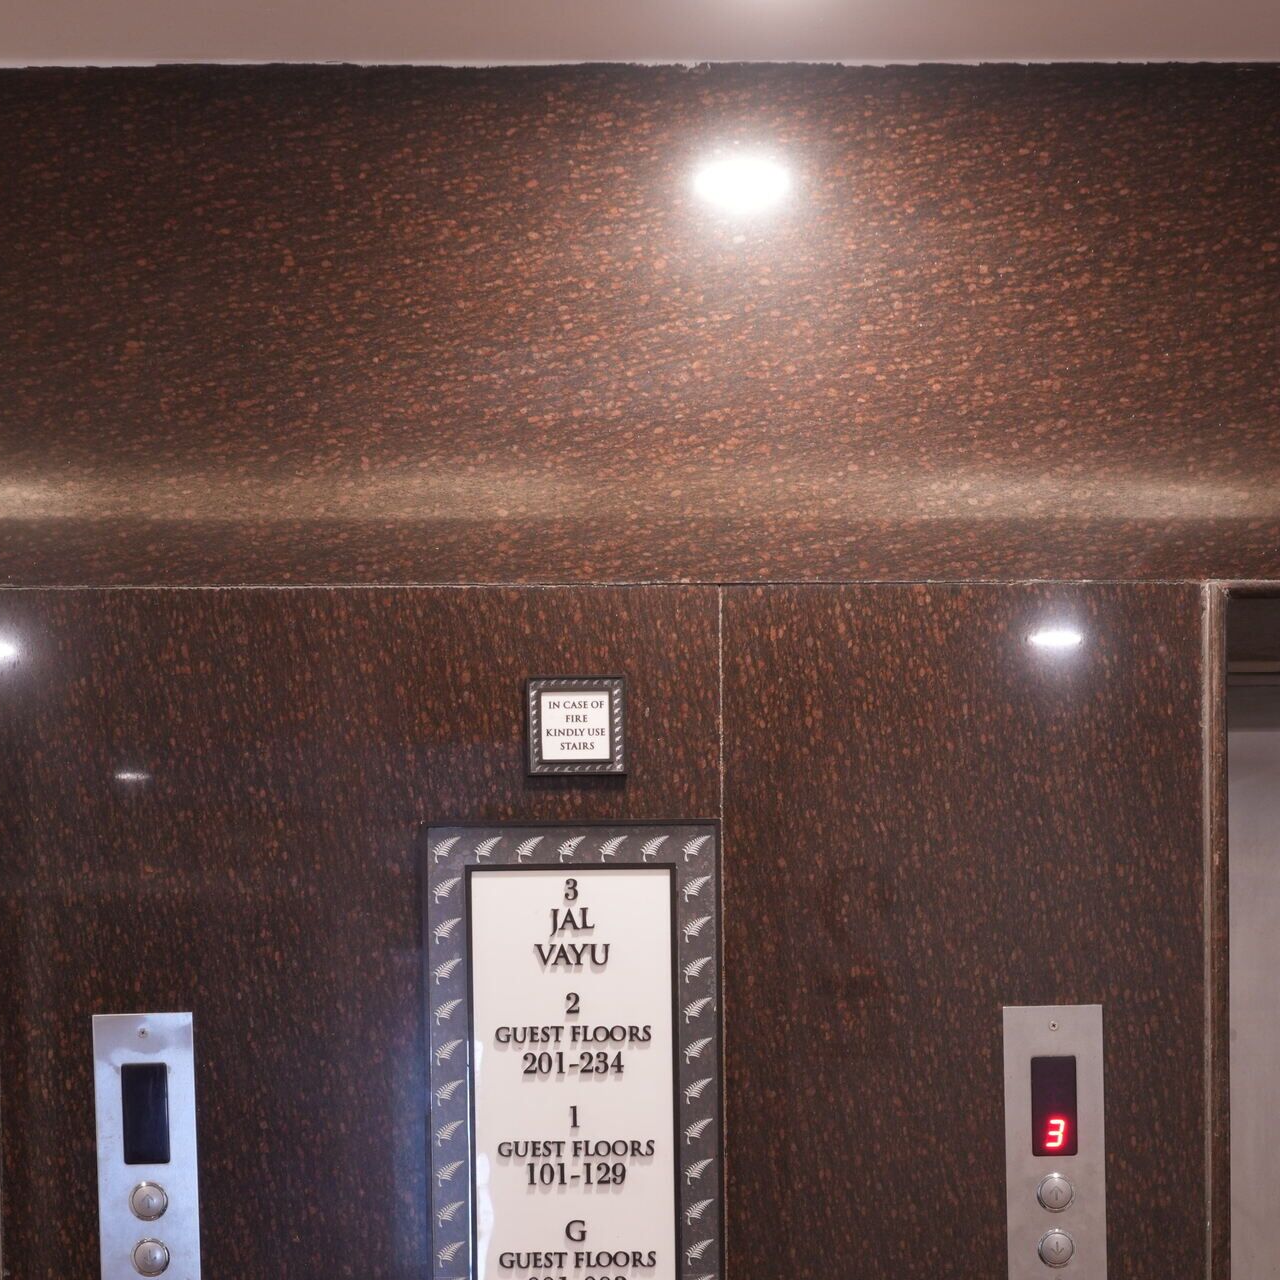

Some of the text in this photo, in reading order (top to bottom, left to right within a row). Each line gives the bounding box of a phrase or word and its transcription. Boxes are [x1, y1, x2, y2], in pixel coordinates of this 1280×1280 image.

[548, 700, 605, 709] IN CASE OF
[565, 714, 589, 723] FIRE
[546, 728, 606, 737] KINDLY USE
[560, 742, 595, 751] STAIRS
[564, 878, 579, 901] 3
[550, 907, 596, 936] JAL
[533, 943, 610, 967] VAYU
[565, 992, 580, 1015] 2
[495, 1024, 652, 1044] GUEST FLOORS
[522, 1052, 625, 1074] 201-234
[569, 1105, 580, 1128] 1
[1045, 1119, 1066, 1148] 3
[497, 1139, 655, 1158] GUEST FLOORS
[526, 1163, 627, 1185] 101-129
[564, 1219, 587, 1242] G
[498, 1251, 657, 1269] GUEST FLOORS
